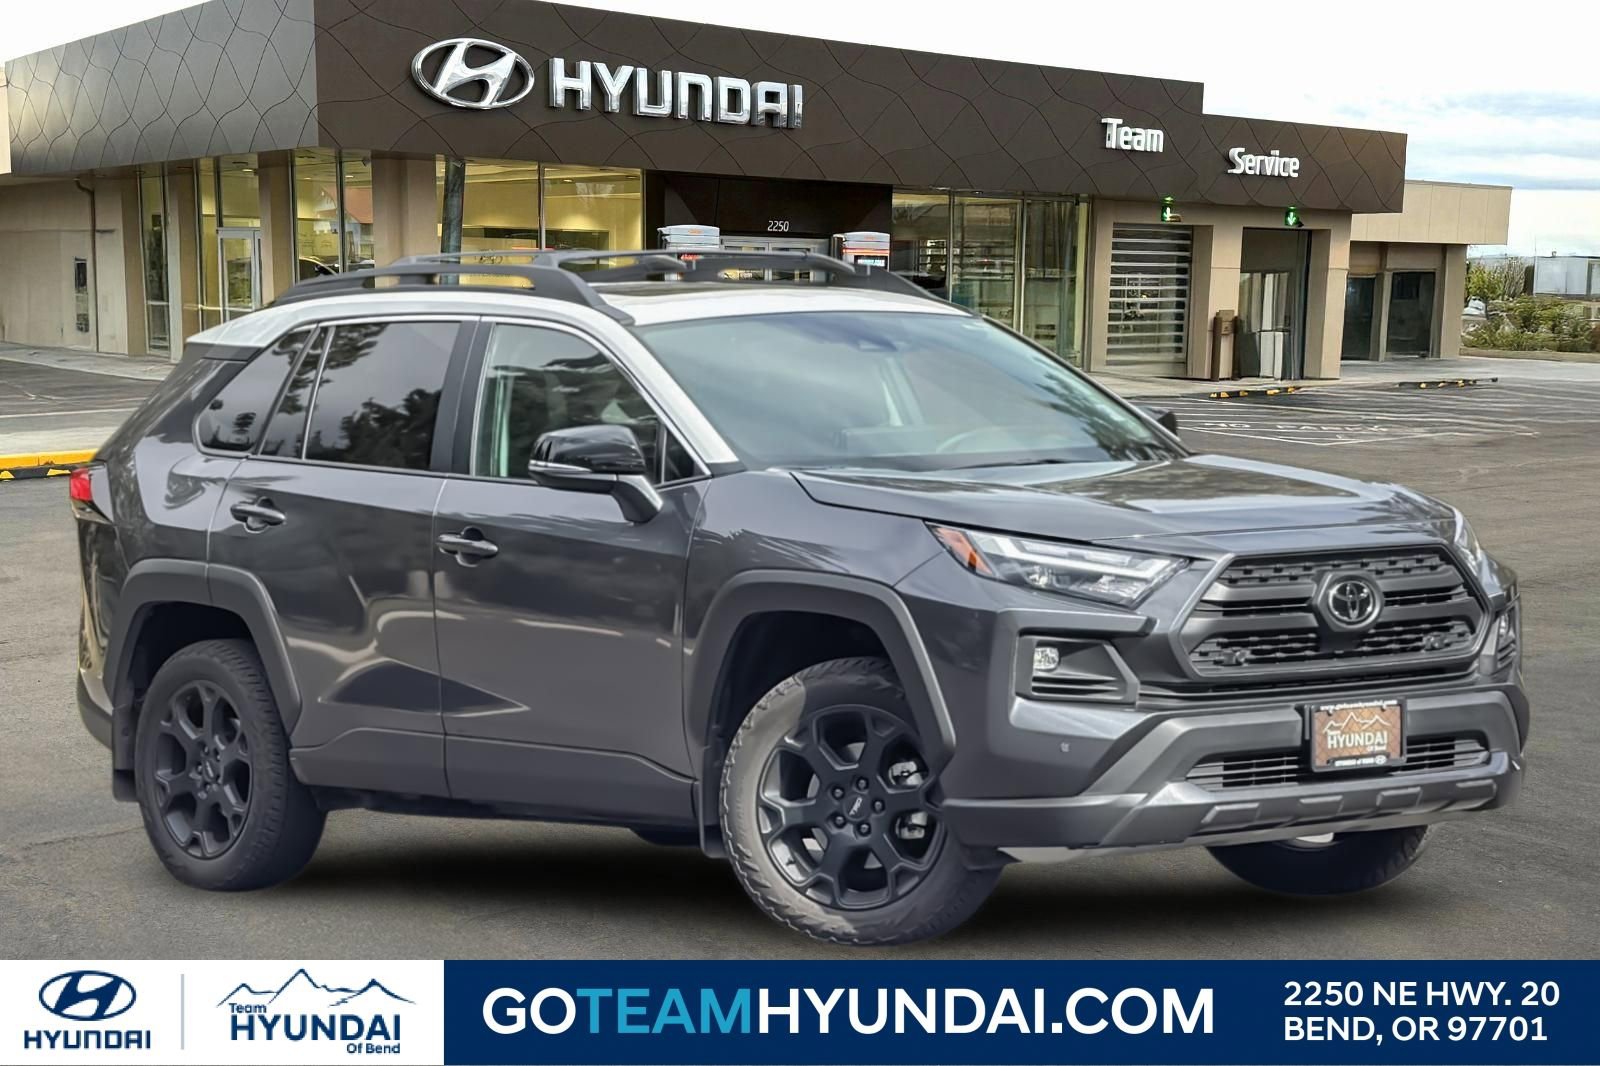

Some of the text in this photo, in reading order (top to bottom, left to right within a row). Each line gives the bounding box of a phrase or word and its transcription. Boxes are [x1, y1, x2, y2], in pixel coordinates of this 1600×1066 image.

[548, 57, 803, 129] HYUNDAI
[1101, 117, 1164, 153] Team
[1227, 147, 1300, 178] Service
[767, 220, 790, 232] 2250
[1327, 731, 1388, 750] HYUNDAI
